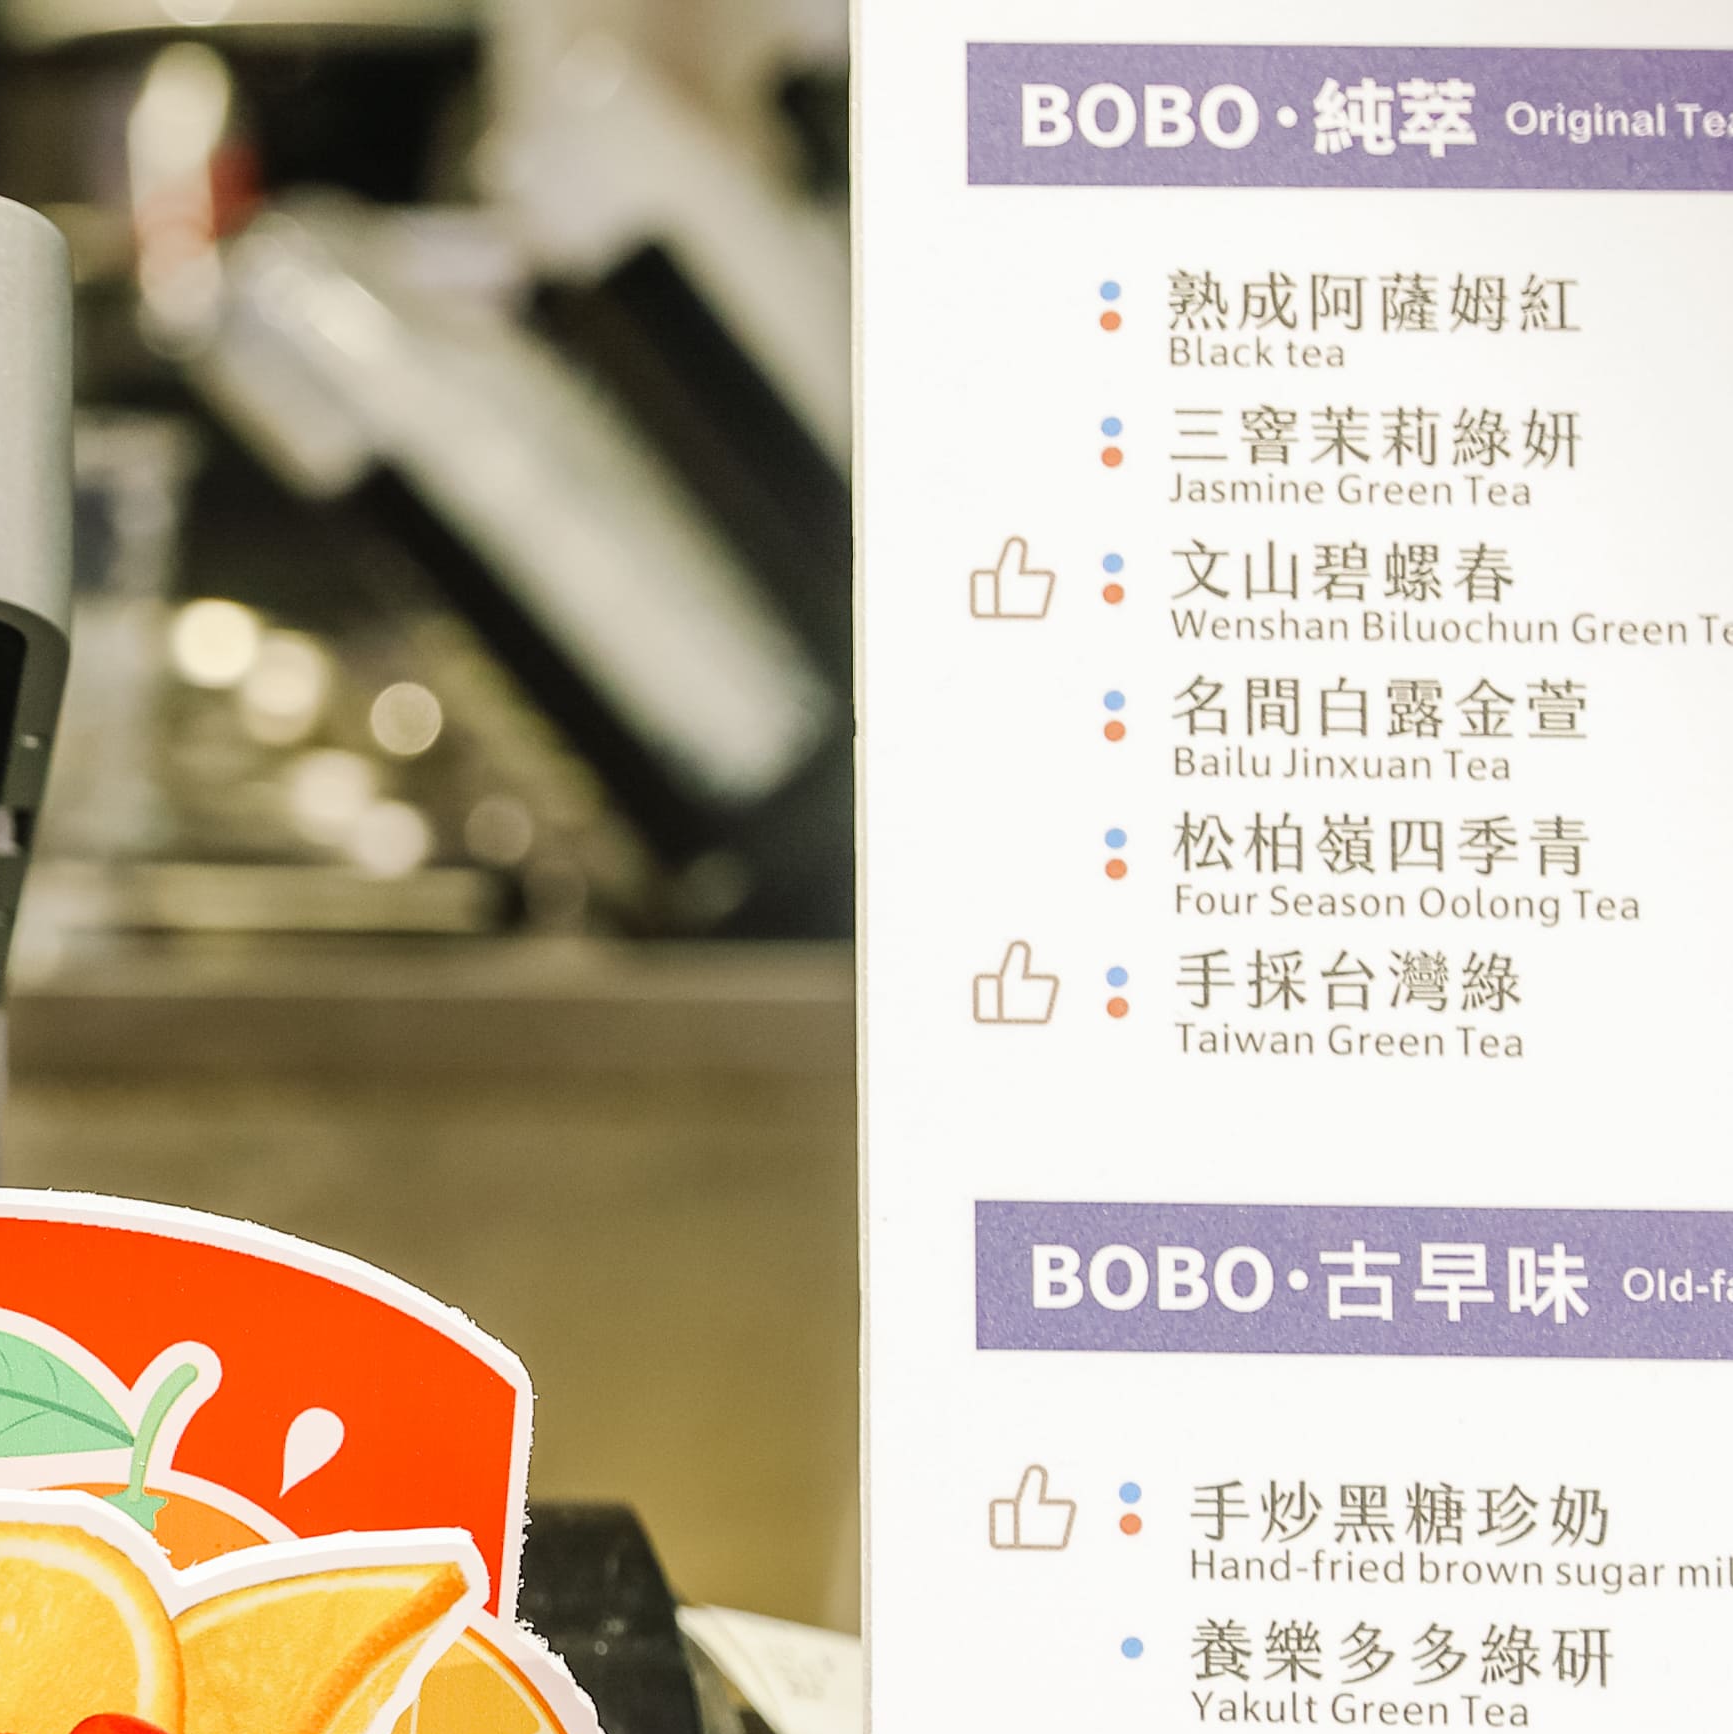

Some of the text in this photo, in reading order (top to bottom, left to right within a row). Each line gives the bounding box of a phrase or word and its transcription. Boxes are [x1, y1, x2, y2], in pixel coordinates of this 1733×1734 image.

[1504, 99, 1667, 145] Original
[1168, 268, 1579, 333] 熟成阿薩姆紅
[1169, 334, 1345, 369] Black tea
[1168, 471, 1532, 507] Jasmine Green Tea
[1171, 538, 1515, 604] 文山碧螺春
[1169, 608, 1349, 642] Wenshan
[1361, 609, 1559, 645] Biluochun
[1570, 612, 1688, 646] Green
[1172, 673, 1587, 740] 名間白露金萱
[1173, 744, 1511, 782] Bailu Jinxuan Tea
[1172, 810, 1589, 878] 松柏嶺四季青
[1174, 883, 1641, 929] Four Season Oolong Tea
[1175, 947, 1522, 1014] 手採台灣綠
[1174, 1022, 1524, 1059] Taiwan Green Tea
[1189, 1478, 1609, 1548] 手炒黑糖珍奶
[1190, 1547, 1405, 1584] Hand-fried
[1418, 1550, 1544, 1586] brown
[1555, 1561, 1666, 1596] sugar
[1190, 1617, 1614, 1689] 養樂多多綠研
[1190, 1689, 1530, 1729] Yakult Green Tea
